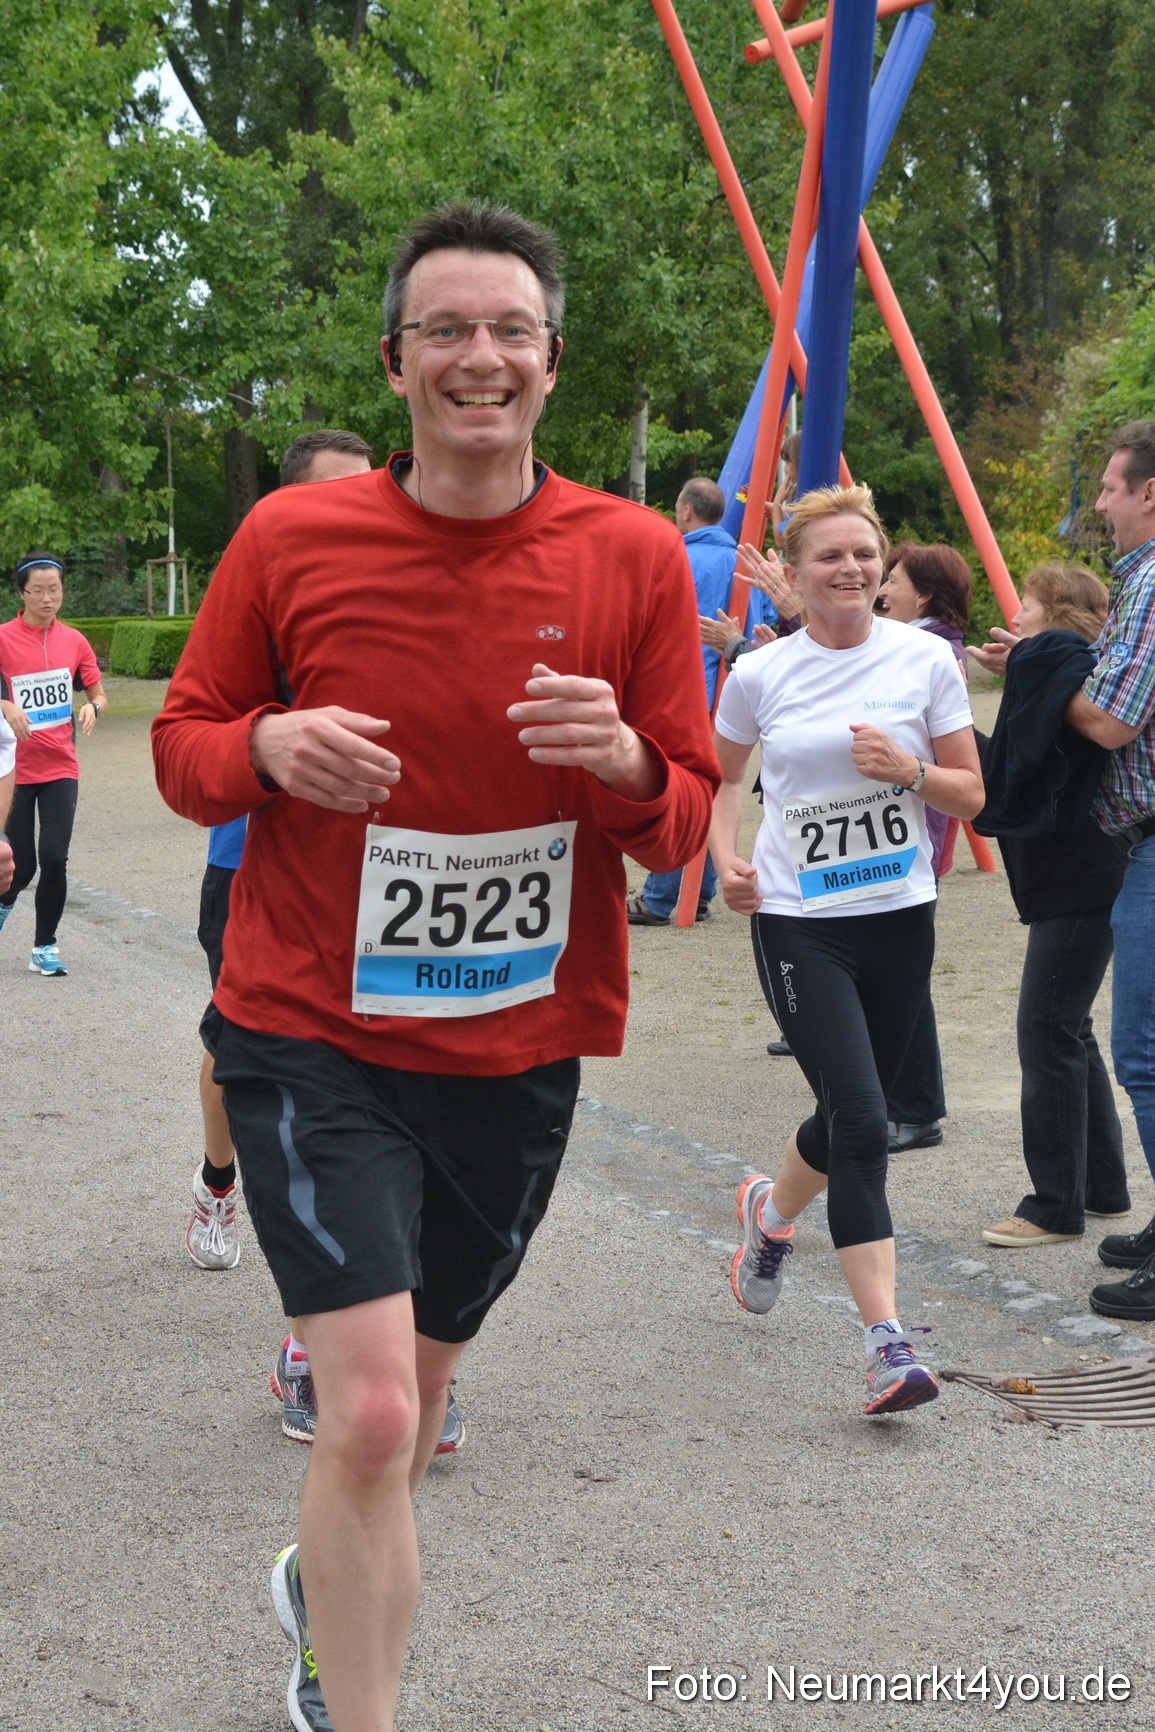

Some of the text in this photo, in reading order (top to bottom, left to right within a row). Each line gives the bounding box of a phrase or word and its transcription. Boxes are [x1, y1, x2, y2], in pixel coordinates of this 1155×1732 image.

[20, 683, 68, 709] 2088
[864, 699, 916, 710] Marianne
[38, 712, 57, 721] Chen
[785, 789, 889, 820] PARTL Neumarkt
[801, 804, 908, 864] 2716
[369, 845, 540, 871] PARTL Neumarkt
[823, 862, 902, 890] Marianne
[380, 871, 551, 948] 2523
[416, 961, 511, 989] Roland
[784, 976, 797, 1013] odlo
